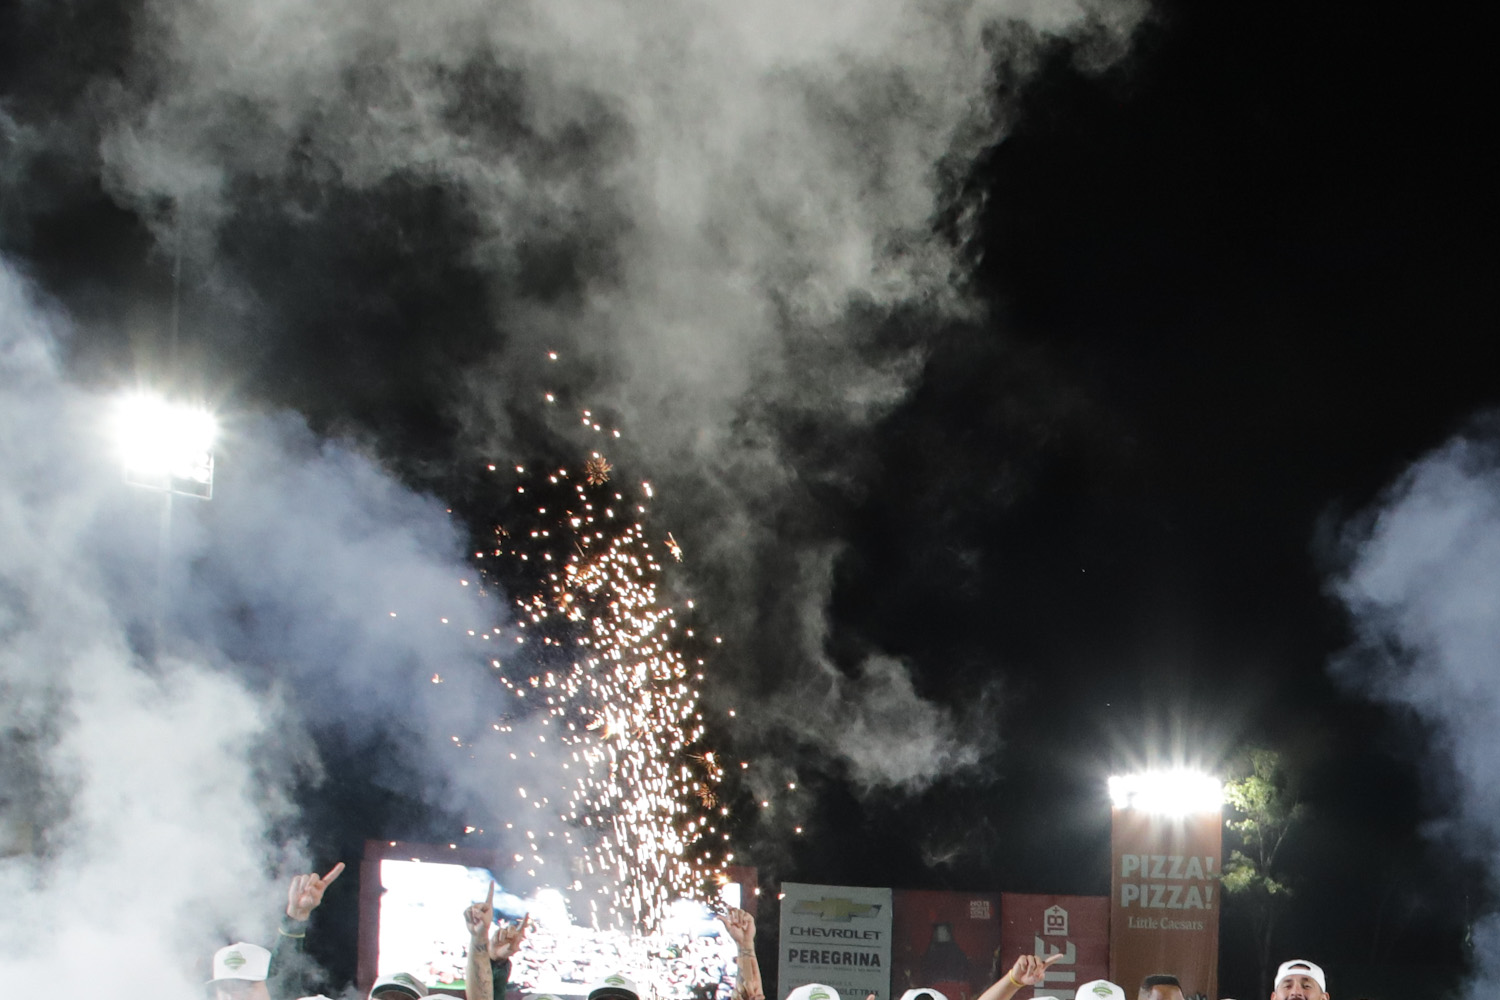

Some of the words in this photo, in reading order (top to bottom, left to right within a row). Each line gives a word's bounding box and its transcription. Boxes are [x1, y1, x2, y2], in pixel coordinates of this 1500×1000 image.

[1121, 854, 1214, 880] PIZZA!
[1121, 884, 1213, 909] PIZZA!
[1046, 906, 1065, 934] 18+
[1128, 916, 1158, 930] Little
[1160, 917, 1204, 930] Caesars
[790, 926, 882, 940] CHEVROLET
[788, 949, 880, 967] PEREGRINA
